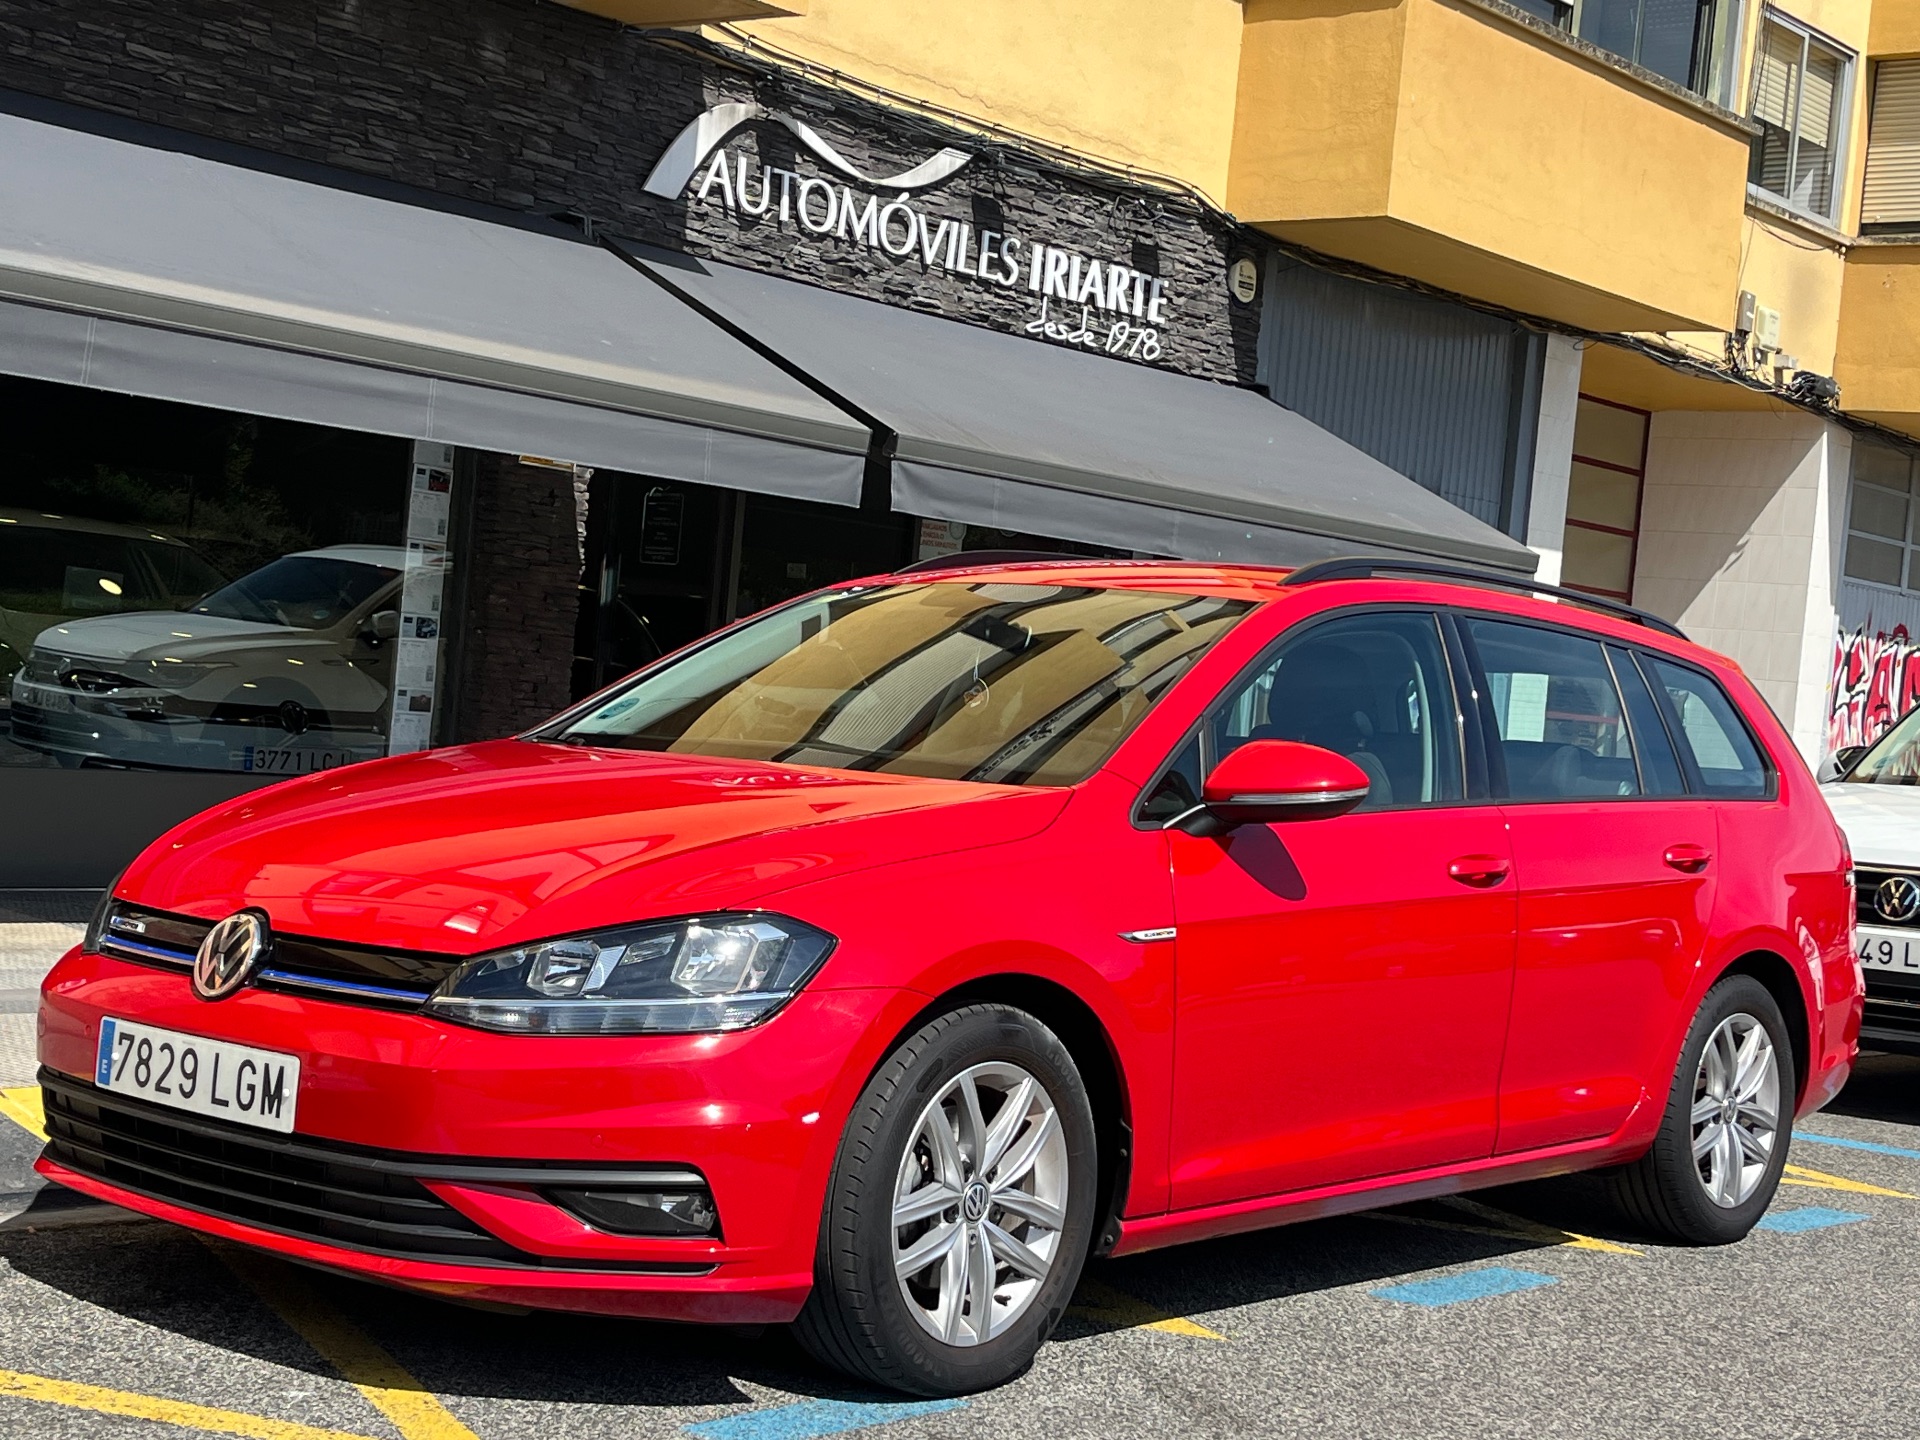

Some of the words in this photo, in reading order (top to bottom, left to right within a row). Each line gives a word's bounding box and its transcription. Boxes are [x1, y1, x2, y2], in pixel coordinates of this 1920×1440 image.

[697, 148, 1021, 286] AUTOMÓVILES
[1029, 244, 1170, 325] IRIARTE
[1025, 295, 1098, 348] desde
[1104, 321, 1161, 361] 1978
[255, 749, 302, 771] 3771
[114, 1031, 199, 1099] 7829
[211, 1052, 285, 1119] LGM
